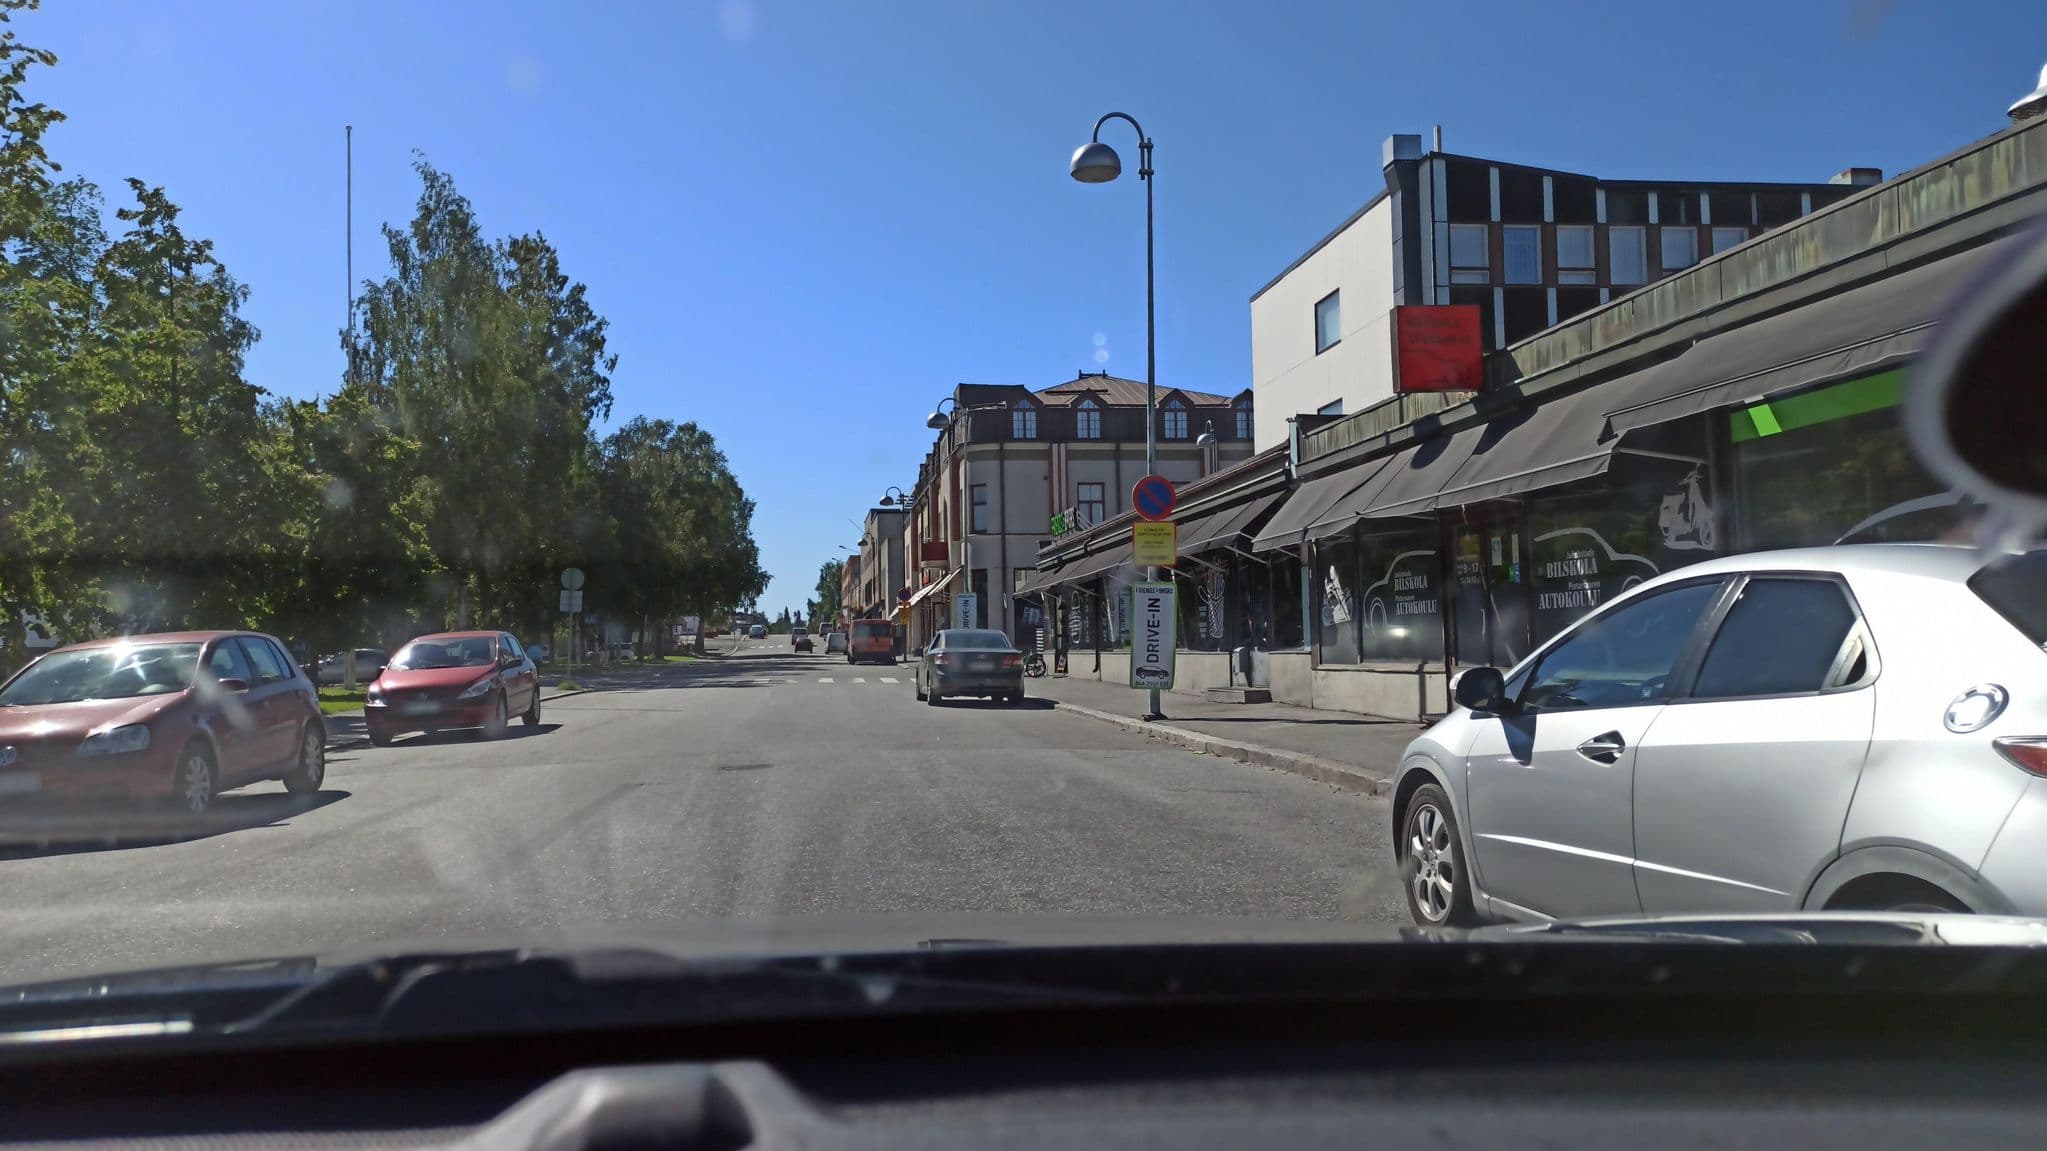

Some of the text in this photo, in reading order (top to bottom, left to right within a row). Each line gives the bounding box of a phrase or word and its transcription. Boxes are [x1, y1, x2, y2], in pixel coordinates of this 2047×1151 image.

[1546, 557, 1598, 579] BILSKOLA
[1394, 575, 1428, 591] BILSKOLA
[1396, 599, 1437, 616] AUTOKOULU
[1539, 589, 1601, 610] AUTOKOULU
[1146, 598, 1161, 663] DRIVE-IN
